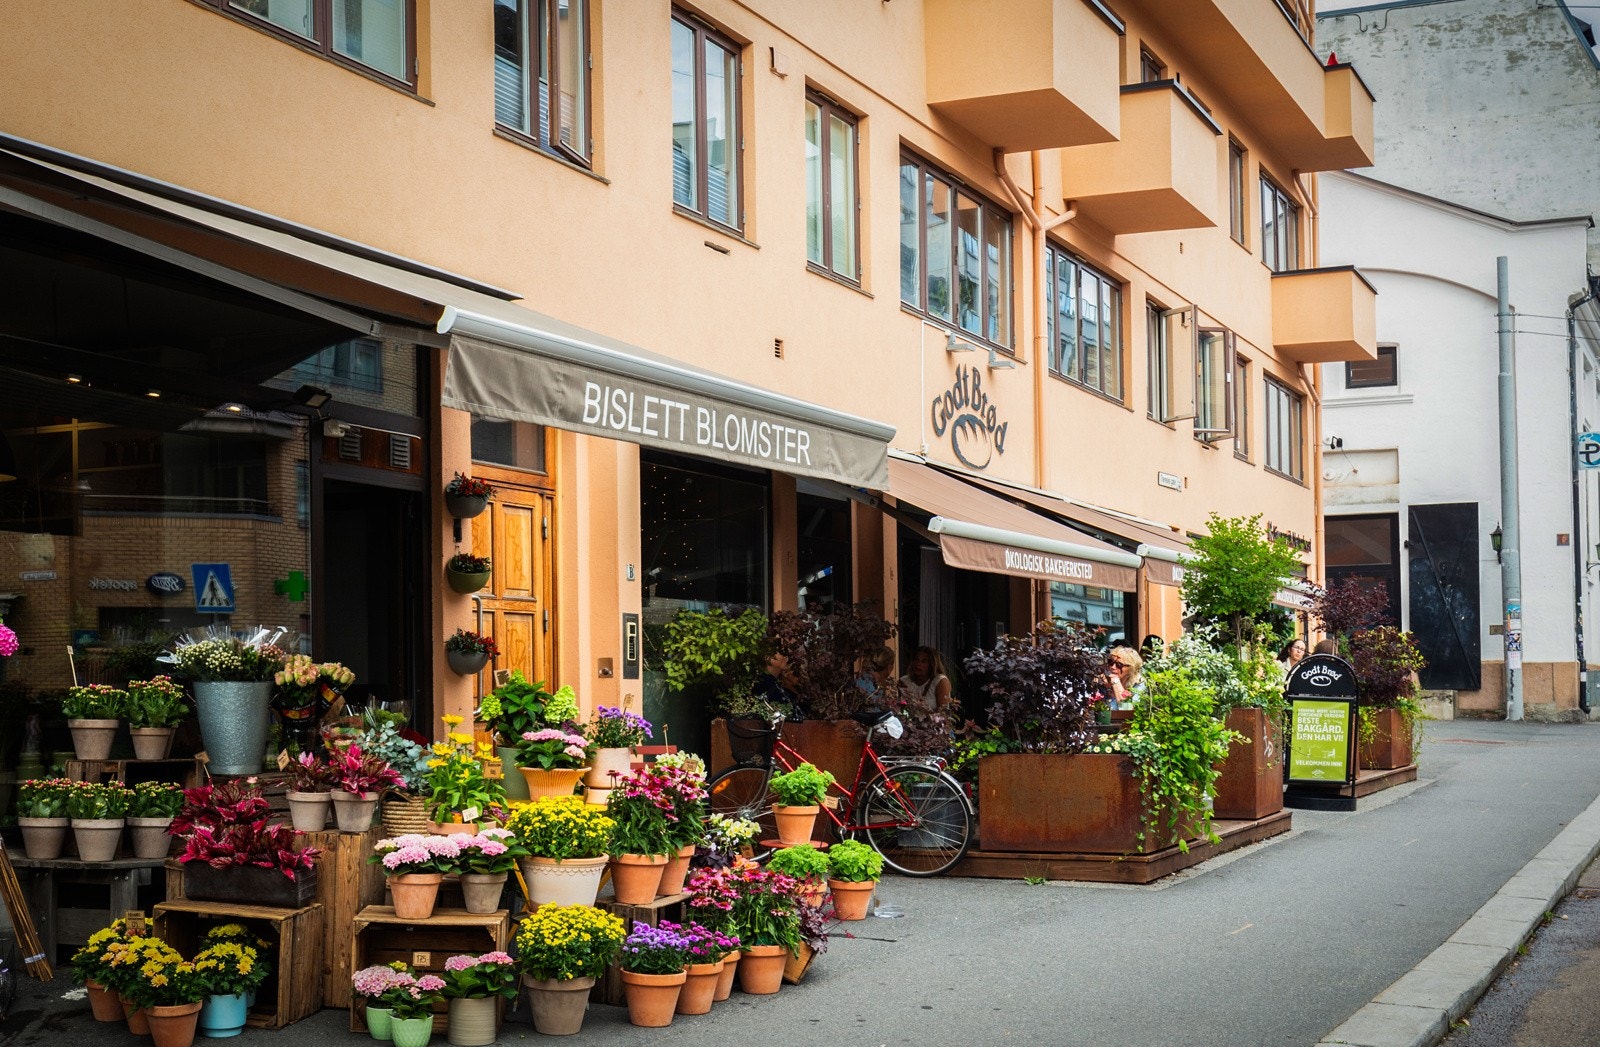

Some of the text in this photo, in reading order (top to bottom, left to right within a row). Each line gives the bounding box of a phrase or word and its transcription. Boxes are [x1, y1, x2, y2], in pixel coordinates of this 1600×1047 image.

[932, 363, 1008, 455] Godt Brød
[582, 381, 811, 466] BISLETT BLOMSTER
[1005, 548, 1093, 579] ØKOLOGISK BAKEVERKSTED
[1301, 665, 1342, 680] Godt Brød
[1296, 733, 1313, 741] DEN
[1297, 722, 1344, 734] BAKGÅRD.
